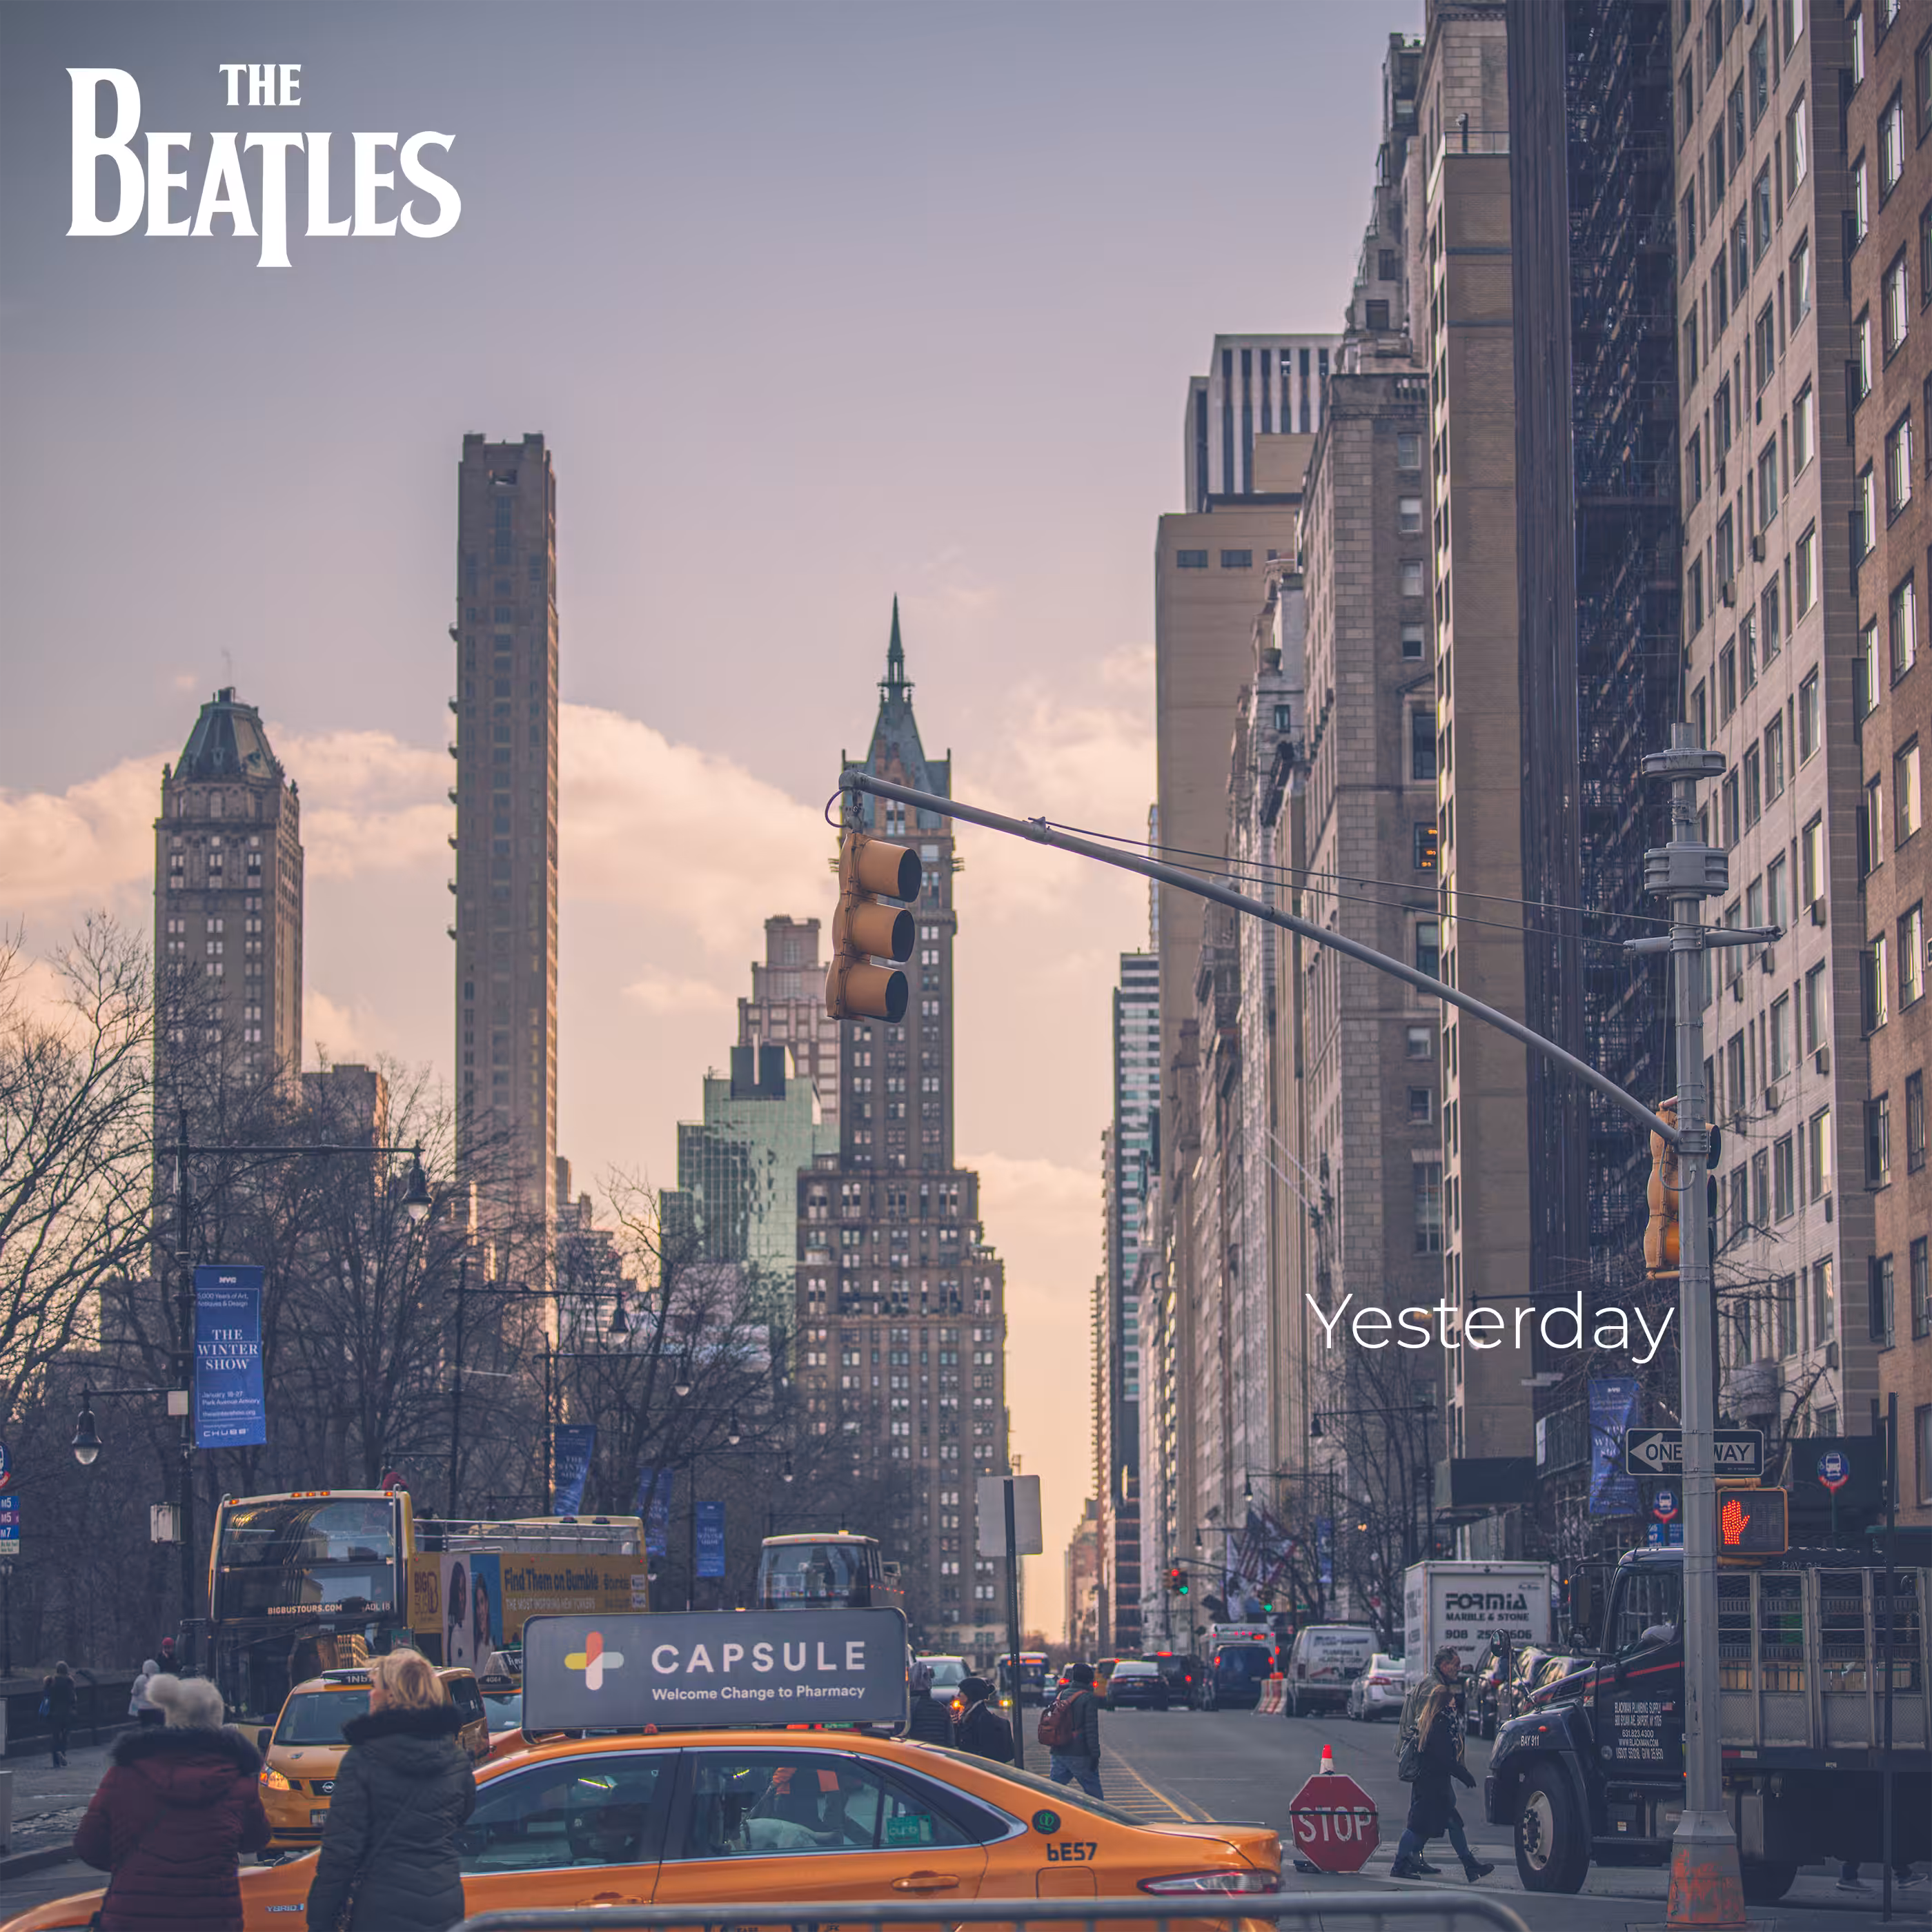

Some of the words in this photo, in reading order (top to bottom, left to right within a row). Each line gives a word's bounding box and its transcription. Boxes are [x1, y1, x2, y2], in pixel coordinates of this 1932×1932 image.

[212, 1329, 243, 1340] THE
[197, 1344, 259, 1355] WINTER
[206, 1359, 250, 1370] SHOW
[1646, 1444, 1682, 1460] ONE
[1714, 1444, 1751, 1461] WAY
[1, 1497, 12, 1508] M5
[1, 1512, 12, 1522] M5
[0, 1527, 12, 1537] M7
[268, 1604, 342, 1615] BIGBUSTOURS.COM
[1446, 1630, 1468, 1639] 908
[651, 1642, 865, 1673] CAPSULE
[652, 1688, 718, 1700] Welcome
[721, 1687, 775, 1701] Change
[778, 1687, 793, 1698] to
[796, 1686, 865, 1698] Pharmacy
[1648, 1702, 1662, 1714] SUPPLY
[1621, 1729, 1654, 1737] 631.823.4300
[1521, 1735, 1531, 1746] BAY
[1531, 1735, 1539, 1746] 911
[1618, 1738, 1659, 1747] WWW.BLACKMAN.COM
[1299, 1806, 1372, 1842] STOP
